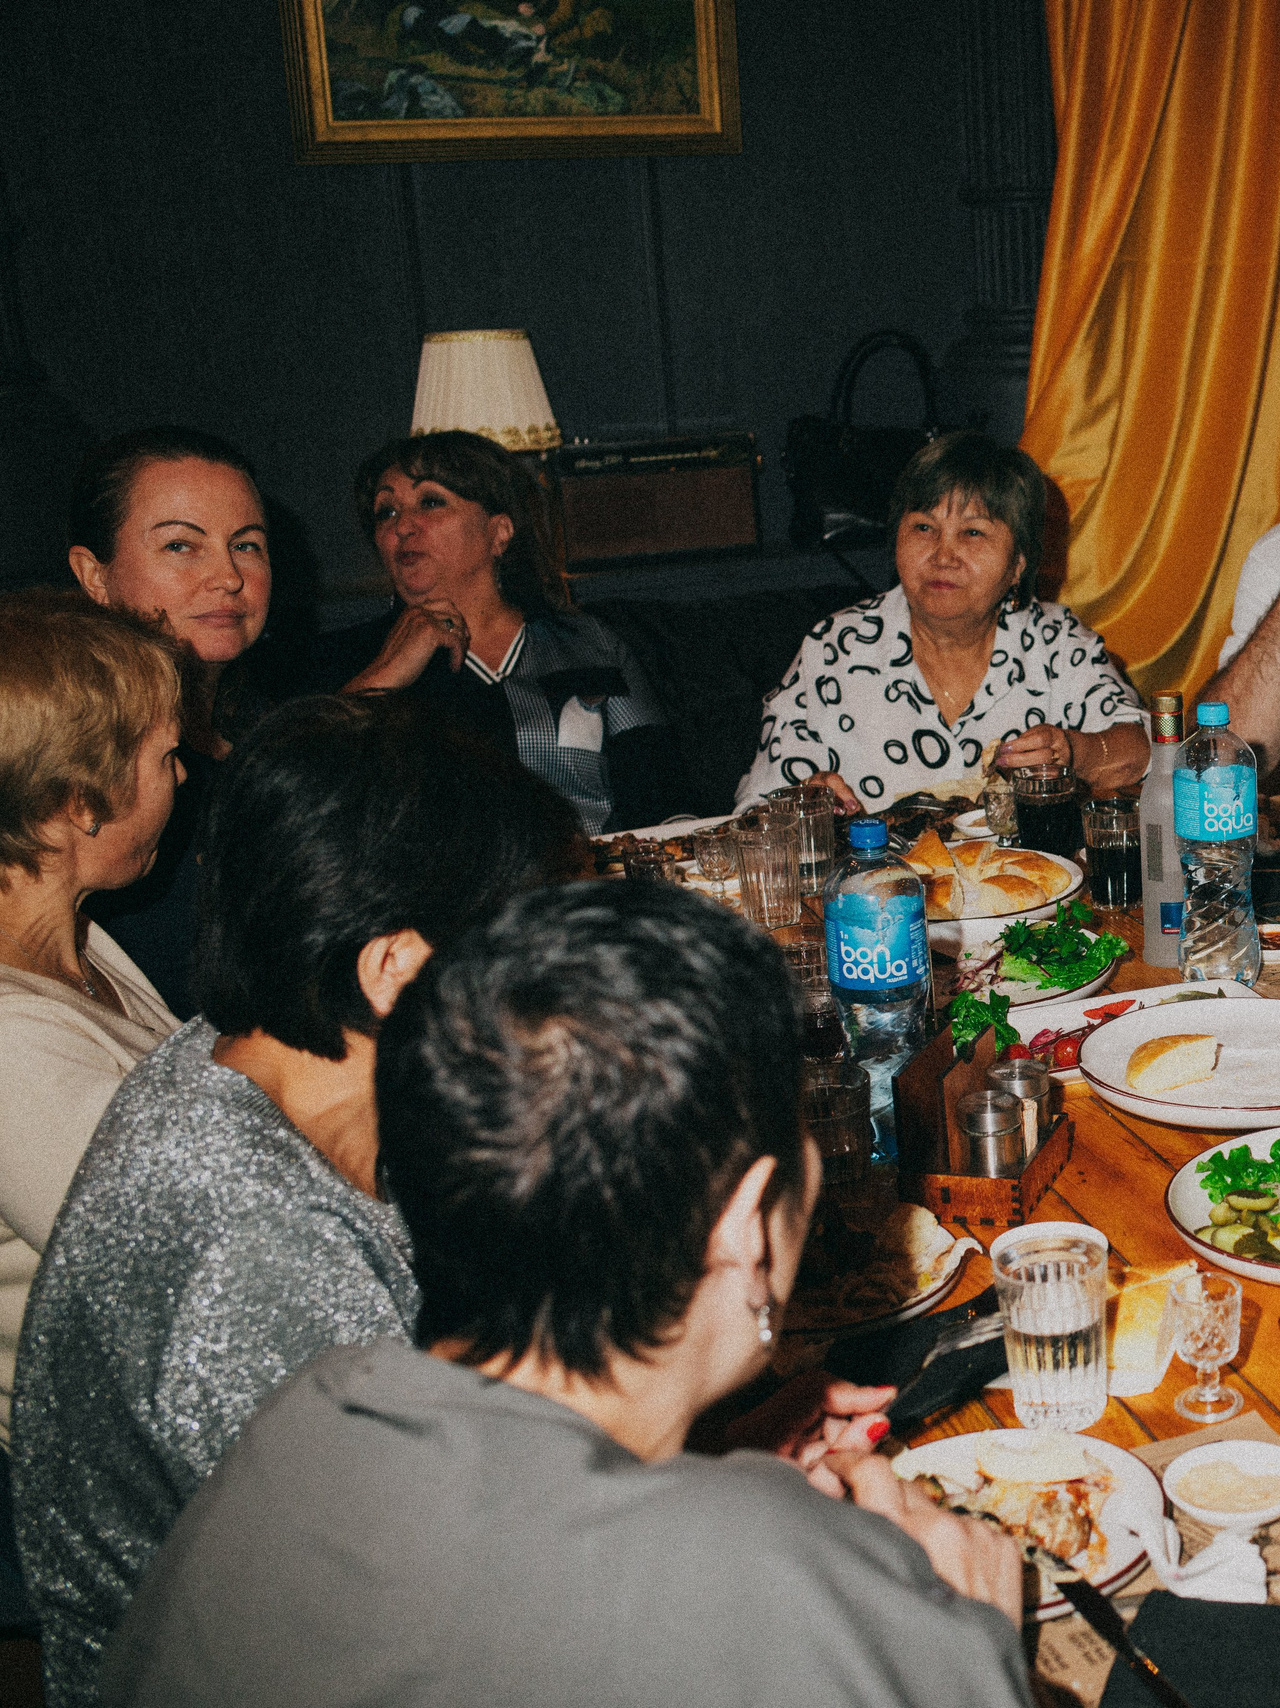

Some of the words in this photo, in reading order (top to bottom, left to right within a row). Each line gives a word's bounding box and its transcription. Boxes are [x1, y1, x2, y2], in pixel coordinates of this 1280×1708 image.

[1203, 800, 1244, 818] bon
[1204, 813, 1254, 834] aqua
[840, 941, 891, 963] bon
[842, 959, 908, 984] aqua
